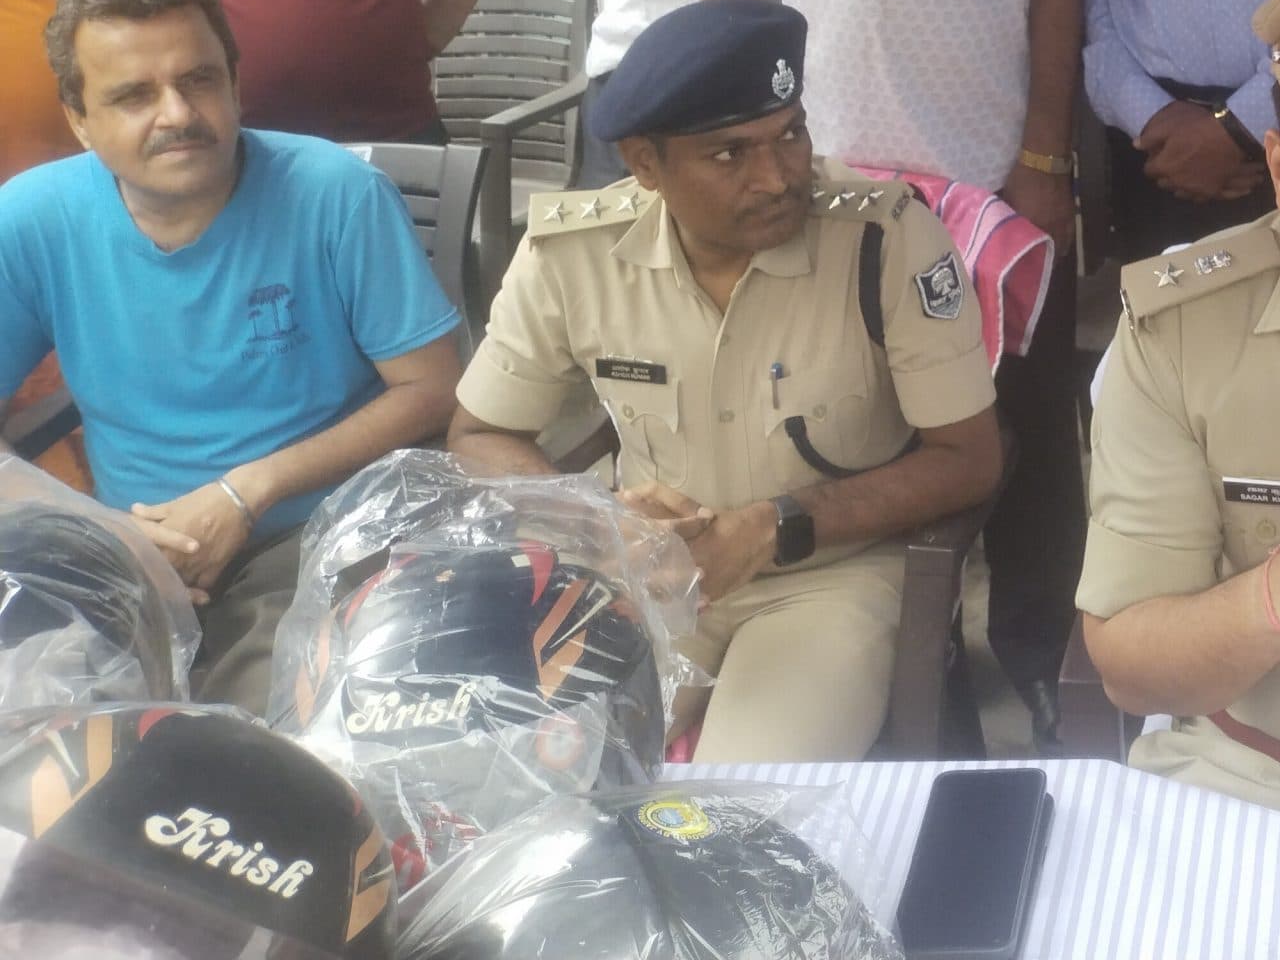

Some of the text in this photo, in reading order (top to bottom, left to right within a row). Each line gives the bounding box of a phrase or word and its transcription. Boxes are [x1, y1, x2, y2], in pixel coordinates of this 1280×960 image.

[1240, 493, 1269, 502] SAGAR
[345, 682, 476, 734] Krish
[144, 807, 314, 899] Krish
